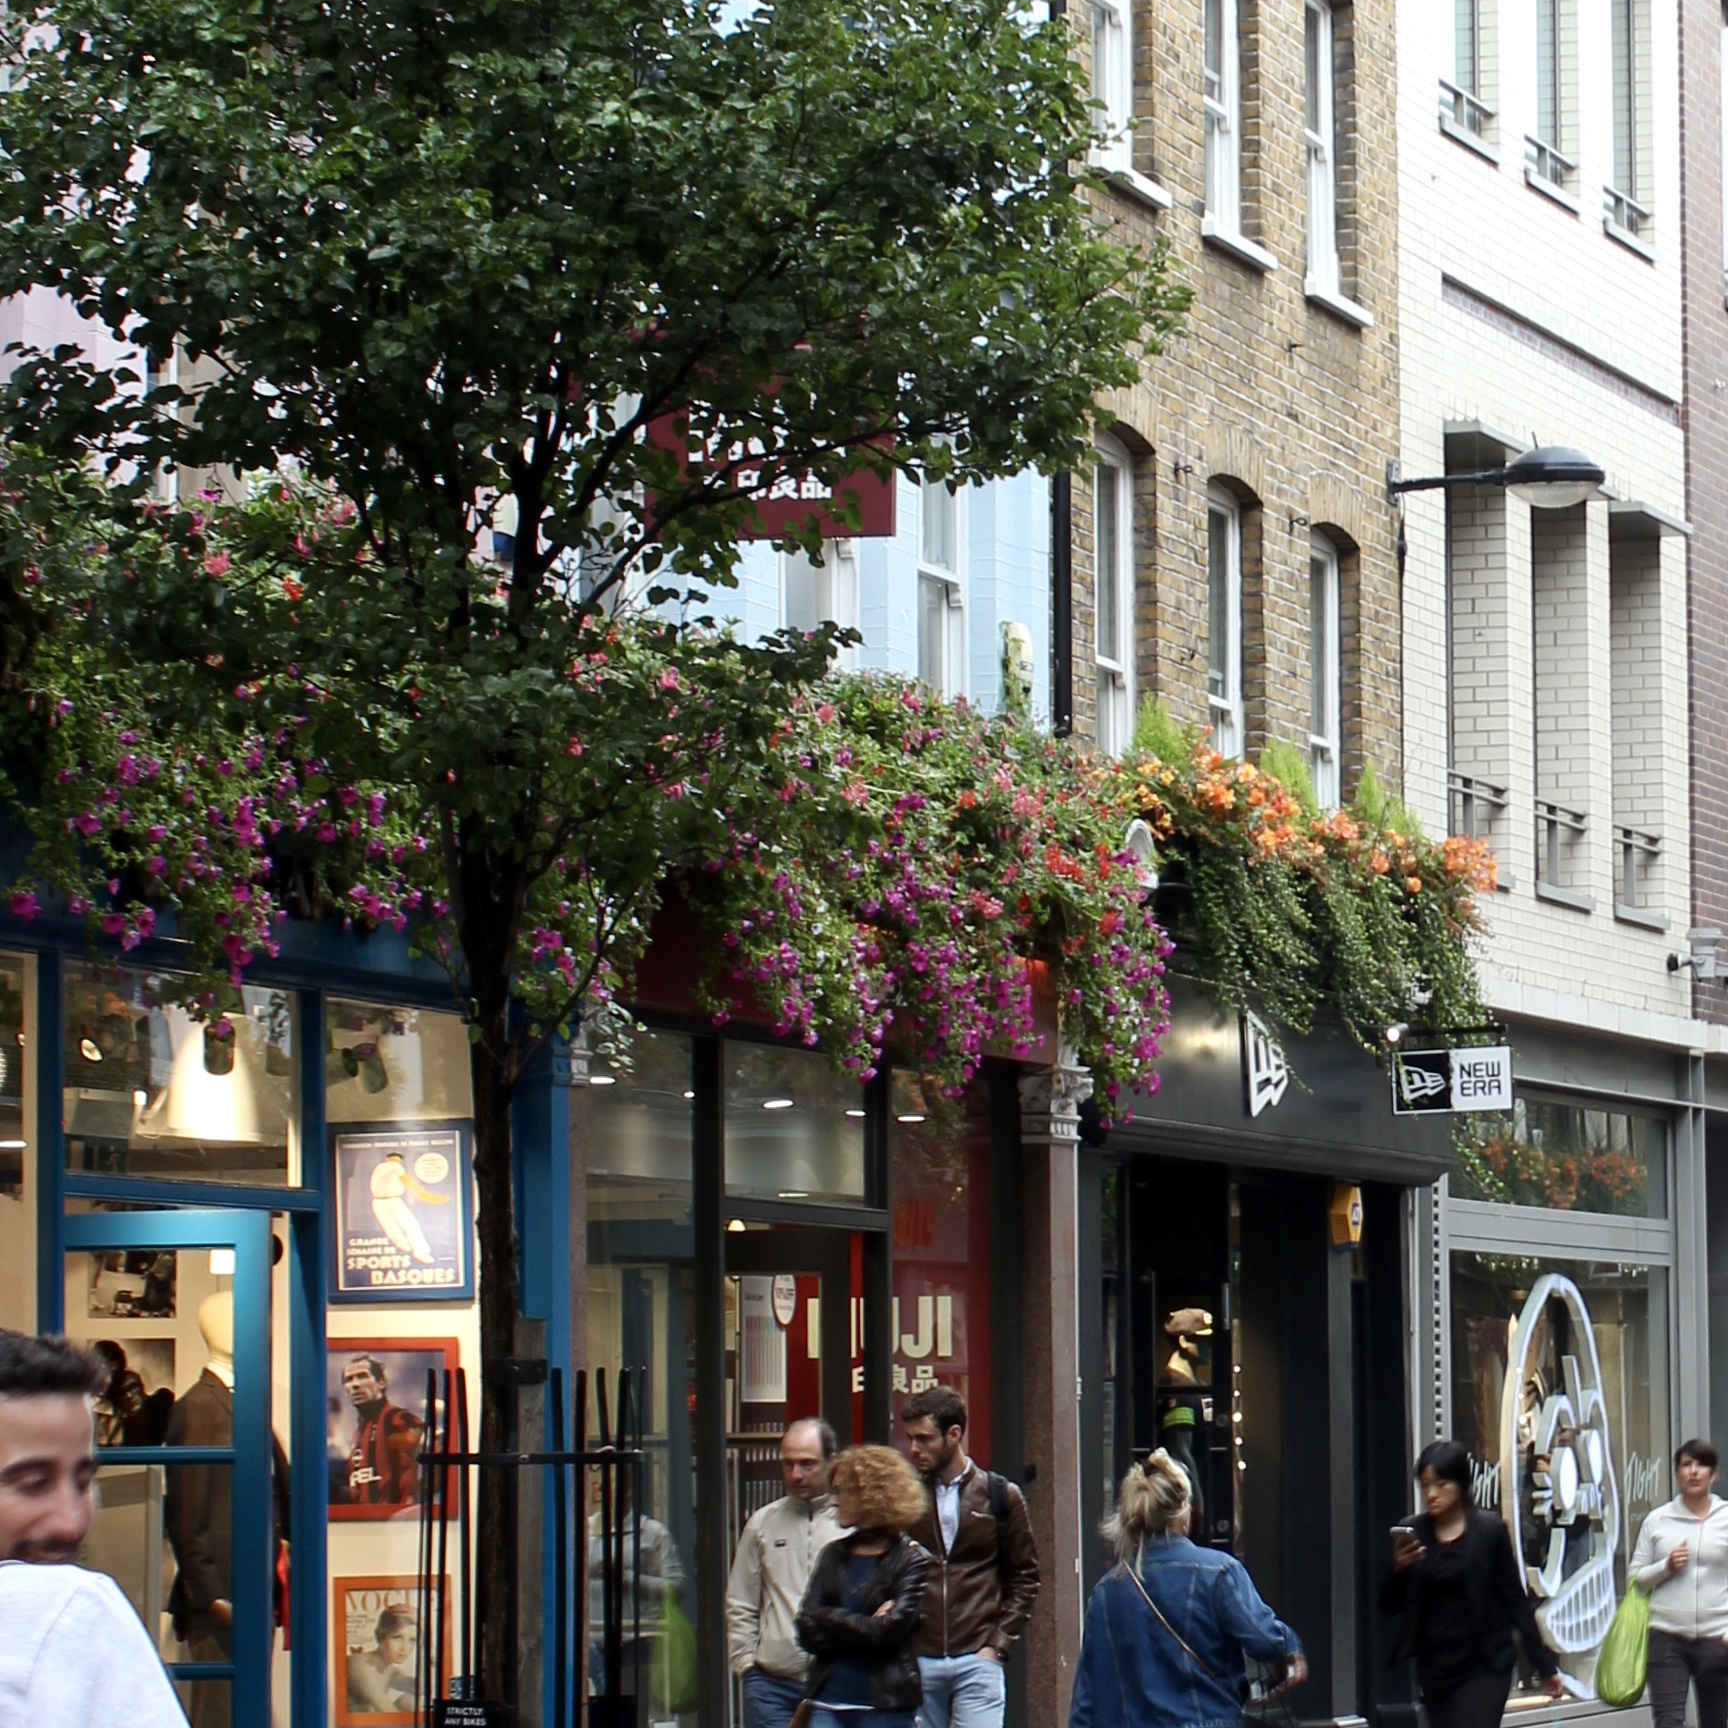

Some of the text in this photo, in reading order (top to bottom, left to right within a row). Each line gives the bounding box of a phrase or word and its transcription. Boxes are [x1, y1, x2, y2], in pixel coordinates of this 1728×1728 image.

[1459, 1060, 1501, 1079] NEW
[1460, 1080, 1502, 1097] ERA
[347, 1255, 411, 1270] SPORTS
[371, 1268, 455, 1285] BASQUES
[349, 1467, 382, 1487] PEL
[446, 1707, 484, 1715] STRICTLY
